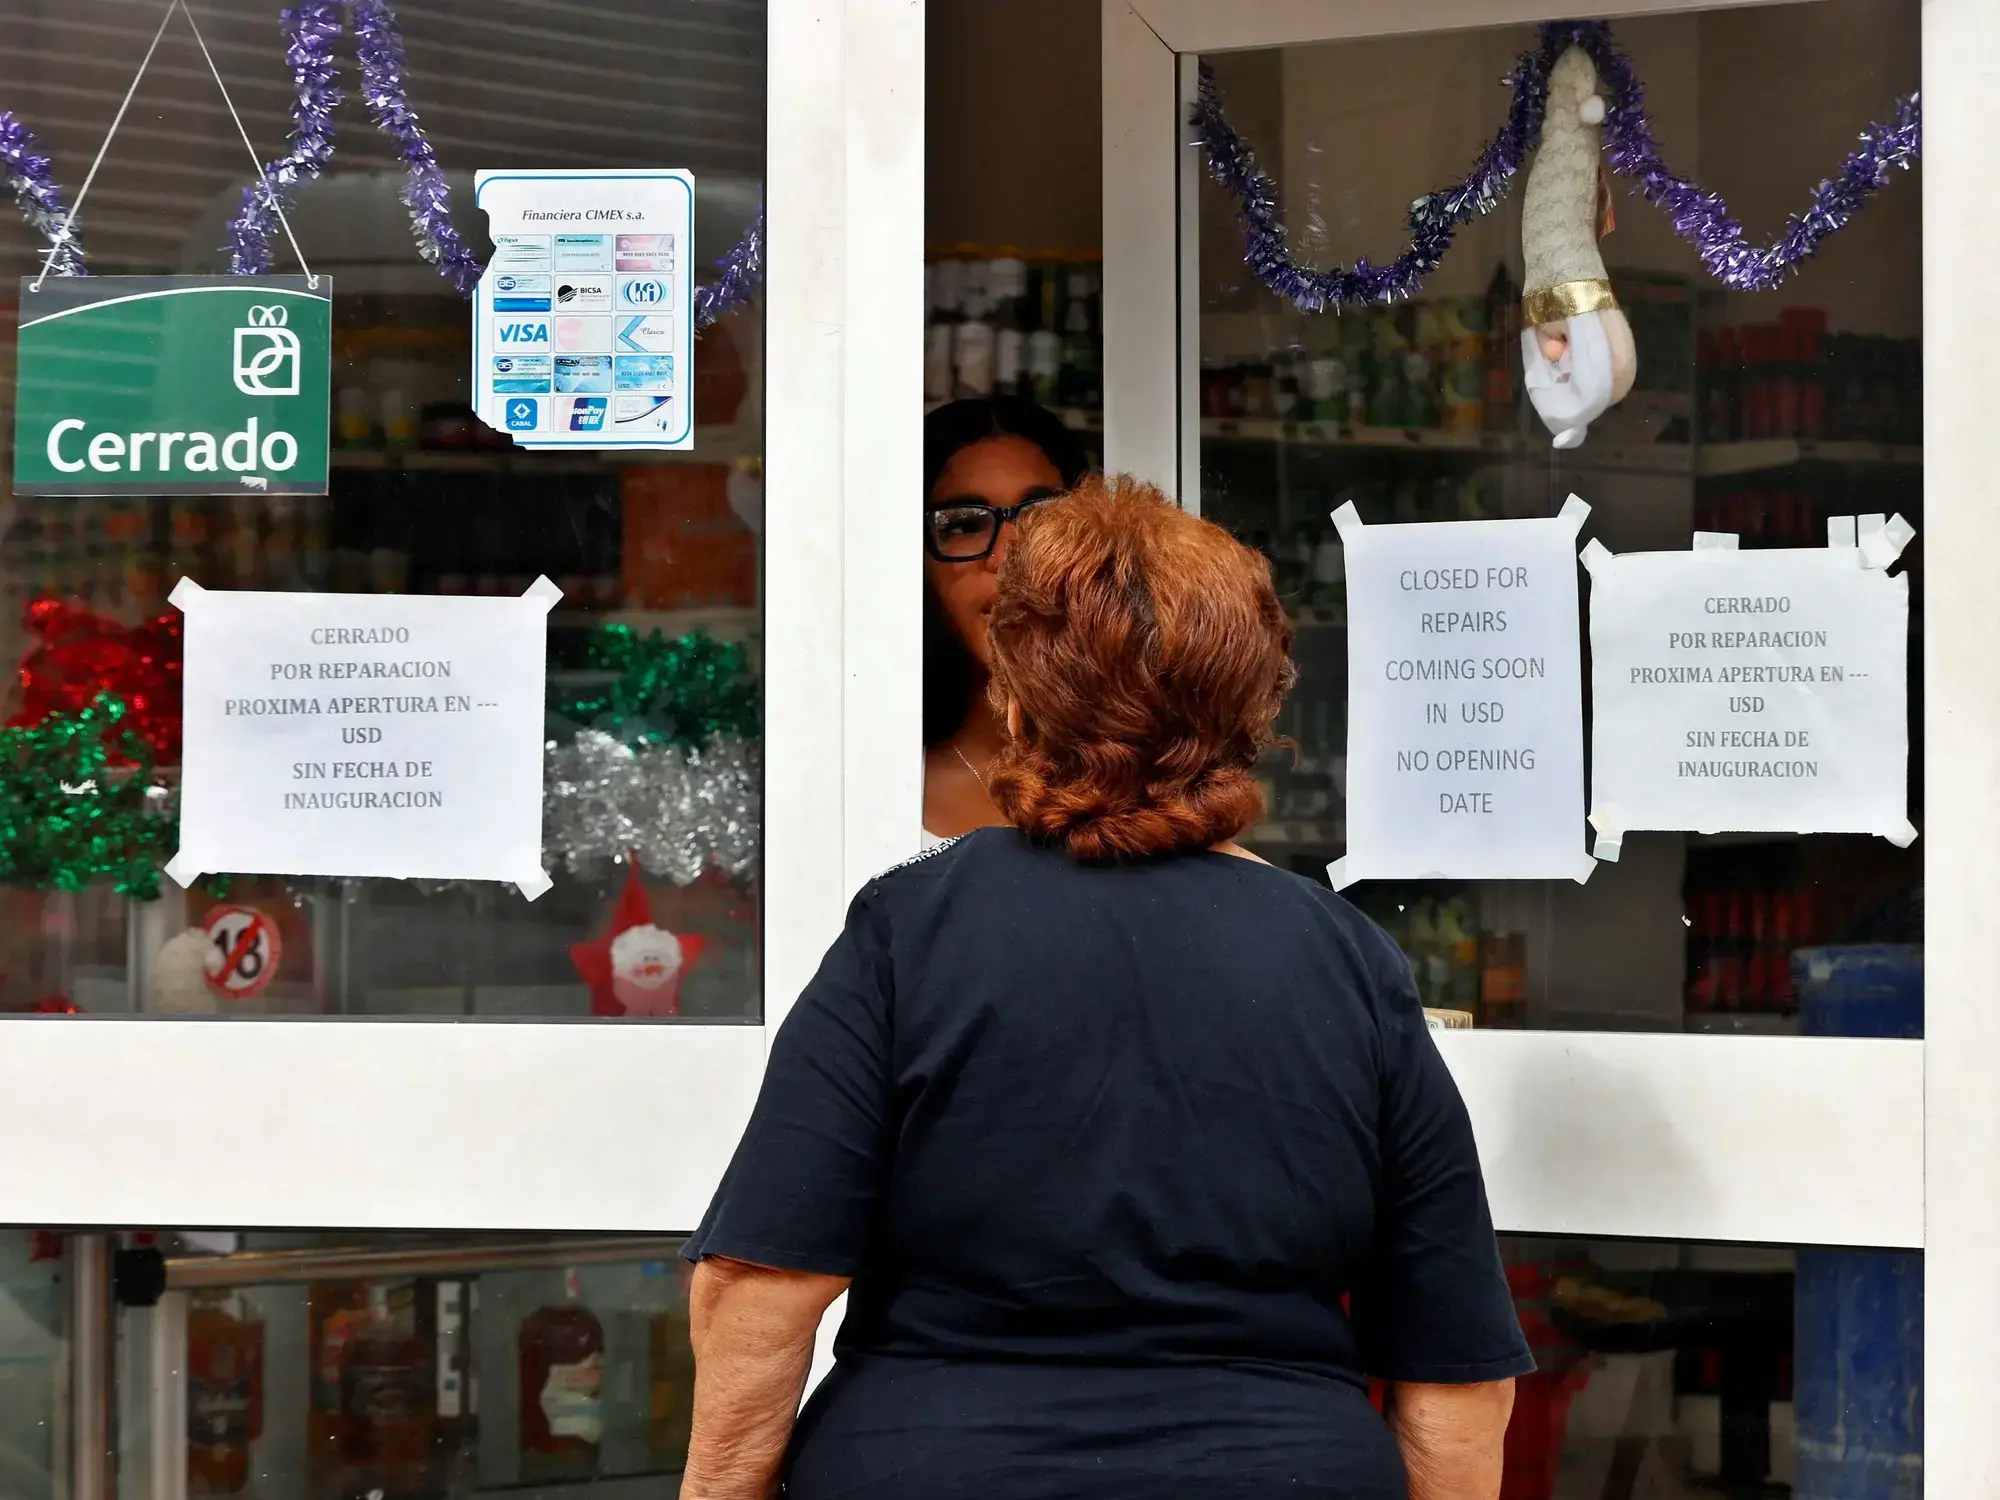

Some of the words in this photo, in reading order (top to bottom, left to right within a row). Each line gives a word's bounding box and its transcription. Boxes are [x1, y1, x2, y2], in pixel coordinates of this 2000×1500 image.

[522, 208, 581, 221] Financiera
[585, 209, 623, 220] CIMEX
[626, 211, 645, 221] s.a.
[500, 323, 549, 342] VISA
[46, 416, 299, 473] Cerrado
[1399, 568, 1479, 592] CLOSED
[1486, 566, 1529, 589] FOR
[1704, 596, 1791, 615] CERRADO
[1421, 610, 1508, 634] REPAIRS
[310, 626, 410, 646] CERRADO
[1668, 632, 1706, 650] POR
[1711, 630, 1827, 649] REPARACION
[270, 663, 313, 681] POR
[318, 660, 452, 680] REPARACION
[1385, 659, 1476, 682] COMING
[1482, 656, 1545, 680] SOON
[1629, 666, 1713, 684] PROXIMA
[1717, 665, 1815, 684] APERTURA
[1820, 665, 1844, 683] EN
[224, 698, 322, 717] PROXIMA
[327, 696, 438, 715] APERTURA
[443, 694, 471, 713] EN
[1426, 702, 1447, 725] IN
[1461, 701, 1505, 724] USD
[1728, 695, 1765, 713] USD
[340, 726, 383, 745] USD
[1685, 731, 1715, 748] SIN
[1720, 730, 1779, 748] FECHA
[1784, 730, 1810, 747] DE
[292, 761, 326, 780] SIN
[332, 761, 400, 779] FECHA
[404, 760, 433, 778] DE
[1397, 750, 1429, 772] NO
[1436, 748, 1535, 771] OPENING
[1677, 760, 1819, 778] INAUGURACION
[283, 790, 443, 810] INAUGURACION
[1439, 792, 1493, 814] DATE
